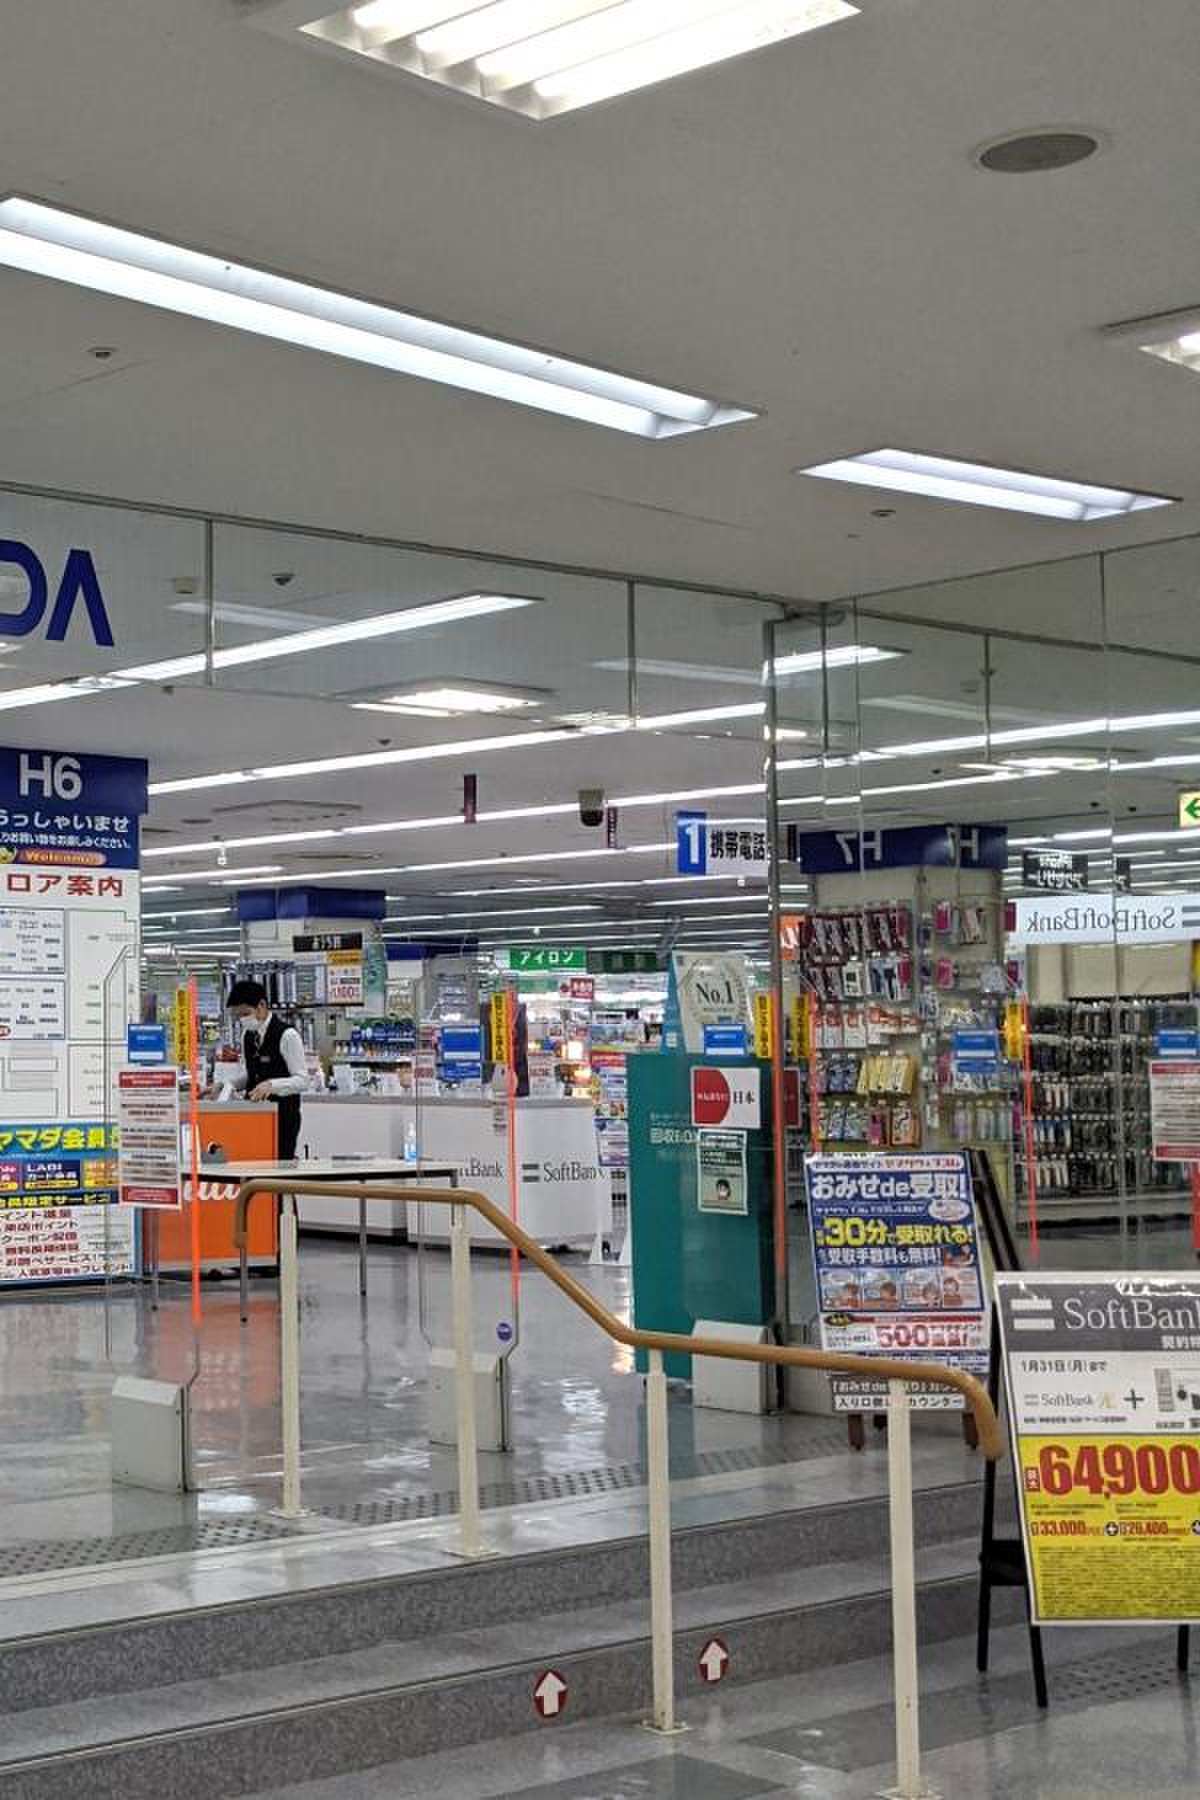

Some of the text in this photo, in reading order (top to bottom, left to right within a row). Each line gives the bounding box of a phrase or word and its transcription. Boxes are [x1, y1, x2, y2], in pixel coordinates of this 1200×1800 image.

[19, 753, 82, 800] H6
[685, 822, 699, 864] 1
[521, 951, 574, 965] アイロン
[811, 1173, 967, 1200] おみせde受取!
[1041, 1393, 1094, 1407] SoftBank
[1040, 1444, 1200, 1500] 64,900
